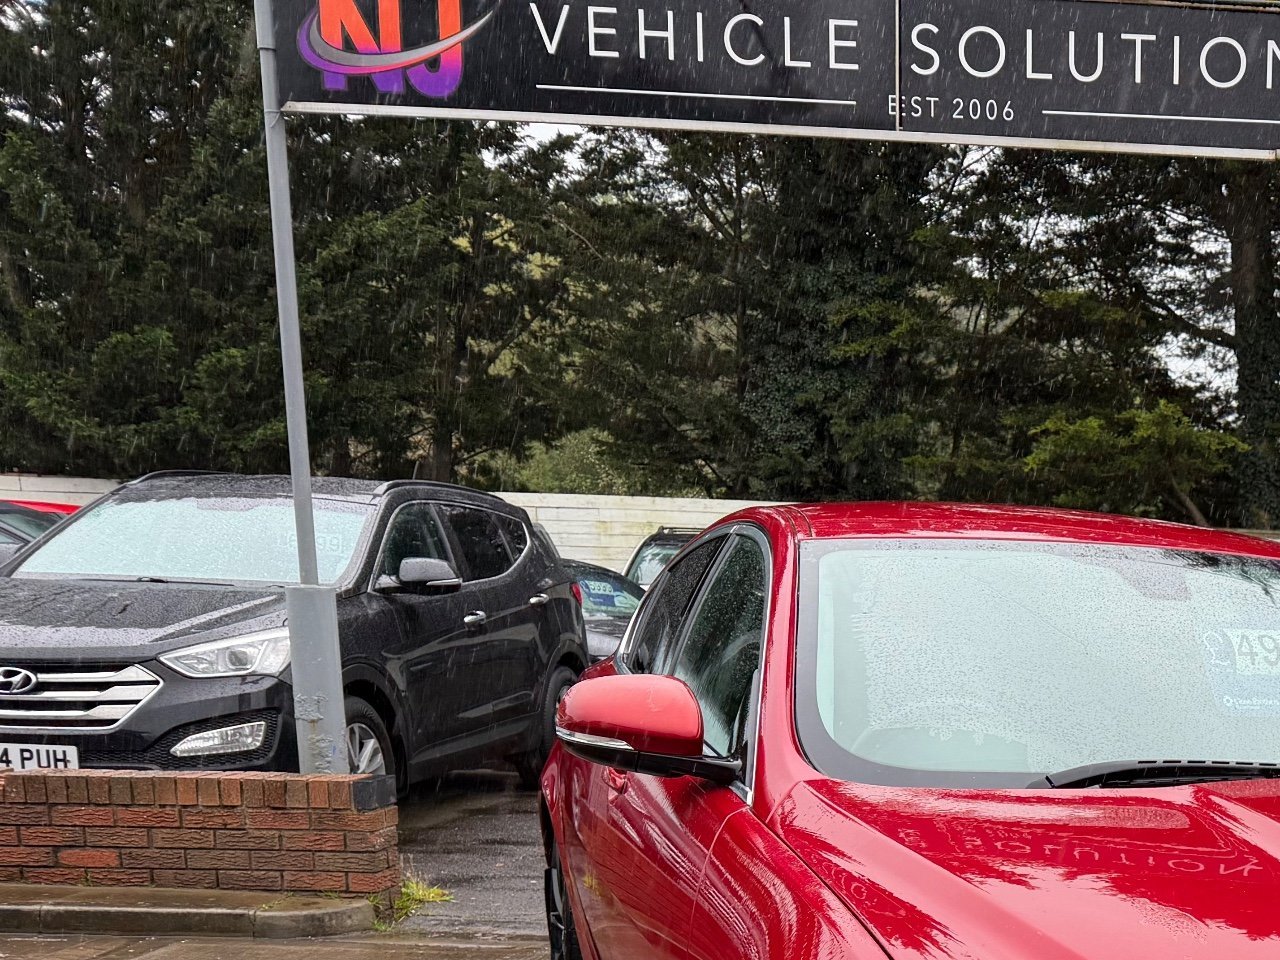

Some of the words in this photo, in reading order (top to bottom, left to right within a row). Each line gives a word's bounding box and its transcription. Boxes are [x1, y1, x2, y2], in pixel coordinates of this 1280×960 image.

[530, 2, 859, 70] VEHICLE
[888, 94, 939, 118] EST
[952, 98, 1014, 121] 2006
[19, 748, 67, 769] PUH
